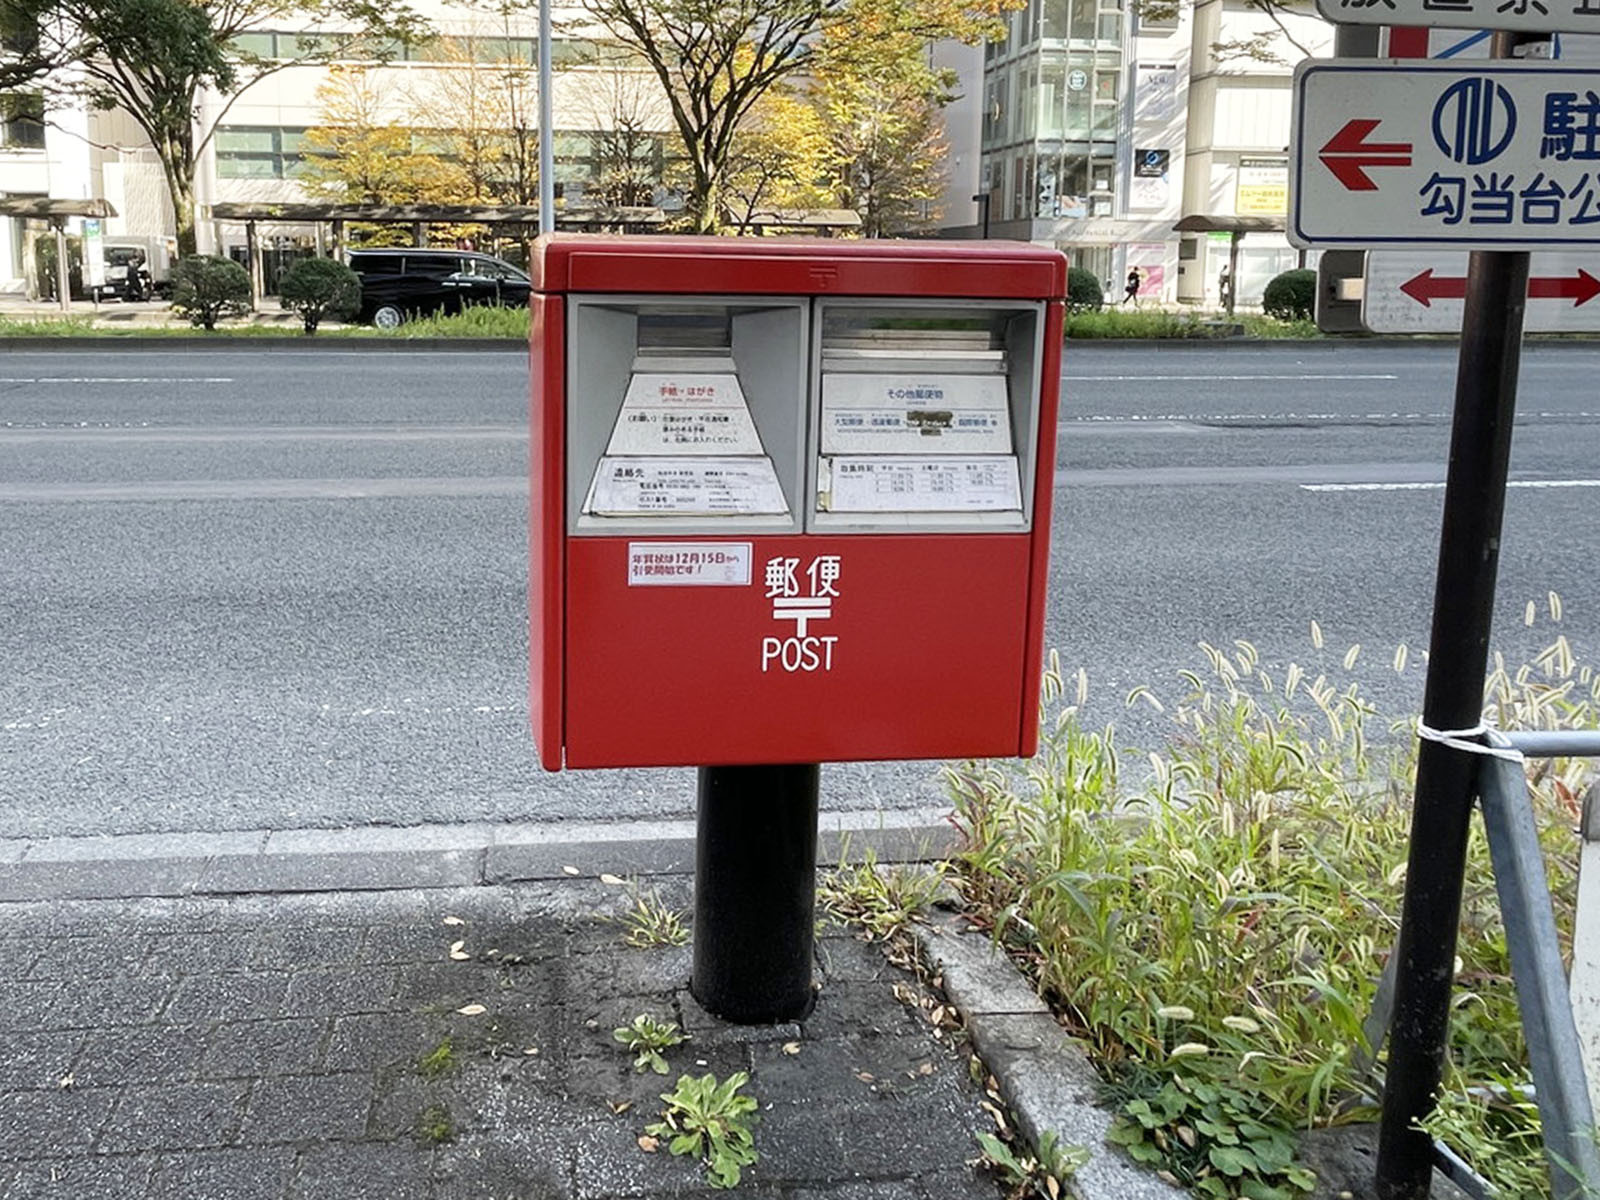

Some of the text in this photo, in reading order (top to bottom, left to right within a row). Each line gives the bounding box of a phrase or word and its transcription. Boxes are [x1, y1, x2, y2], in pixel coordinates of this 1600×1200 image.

[1540, 90, 1600, 161] 駐
[1419, 172, 1600, 225] 勾当台公
[765, 556, 842, 598] 郵便
[762, 637, 839, 672] POST
